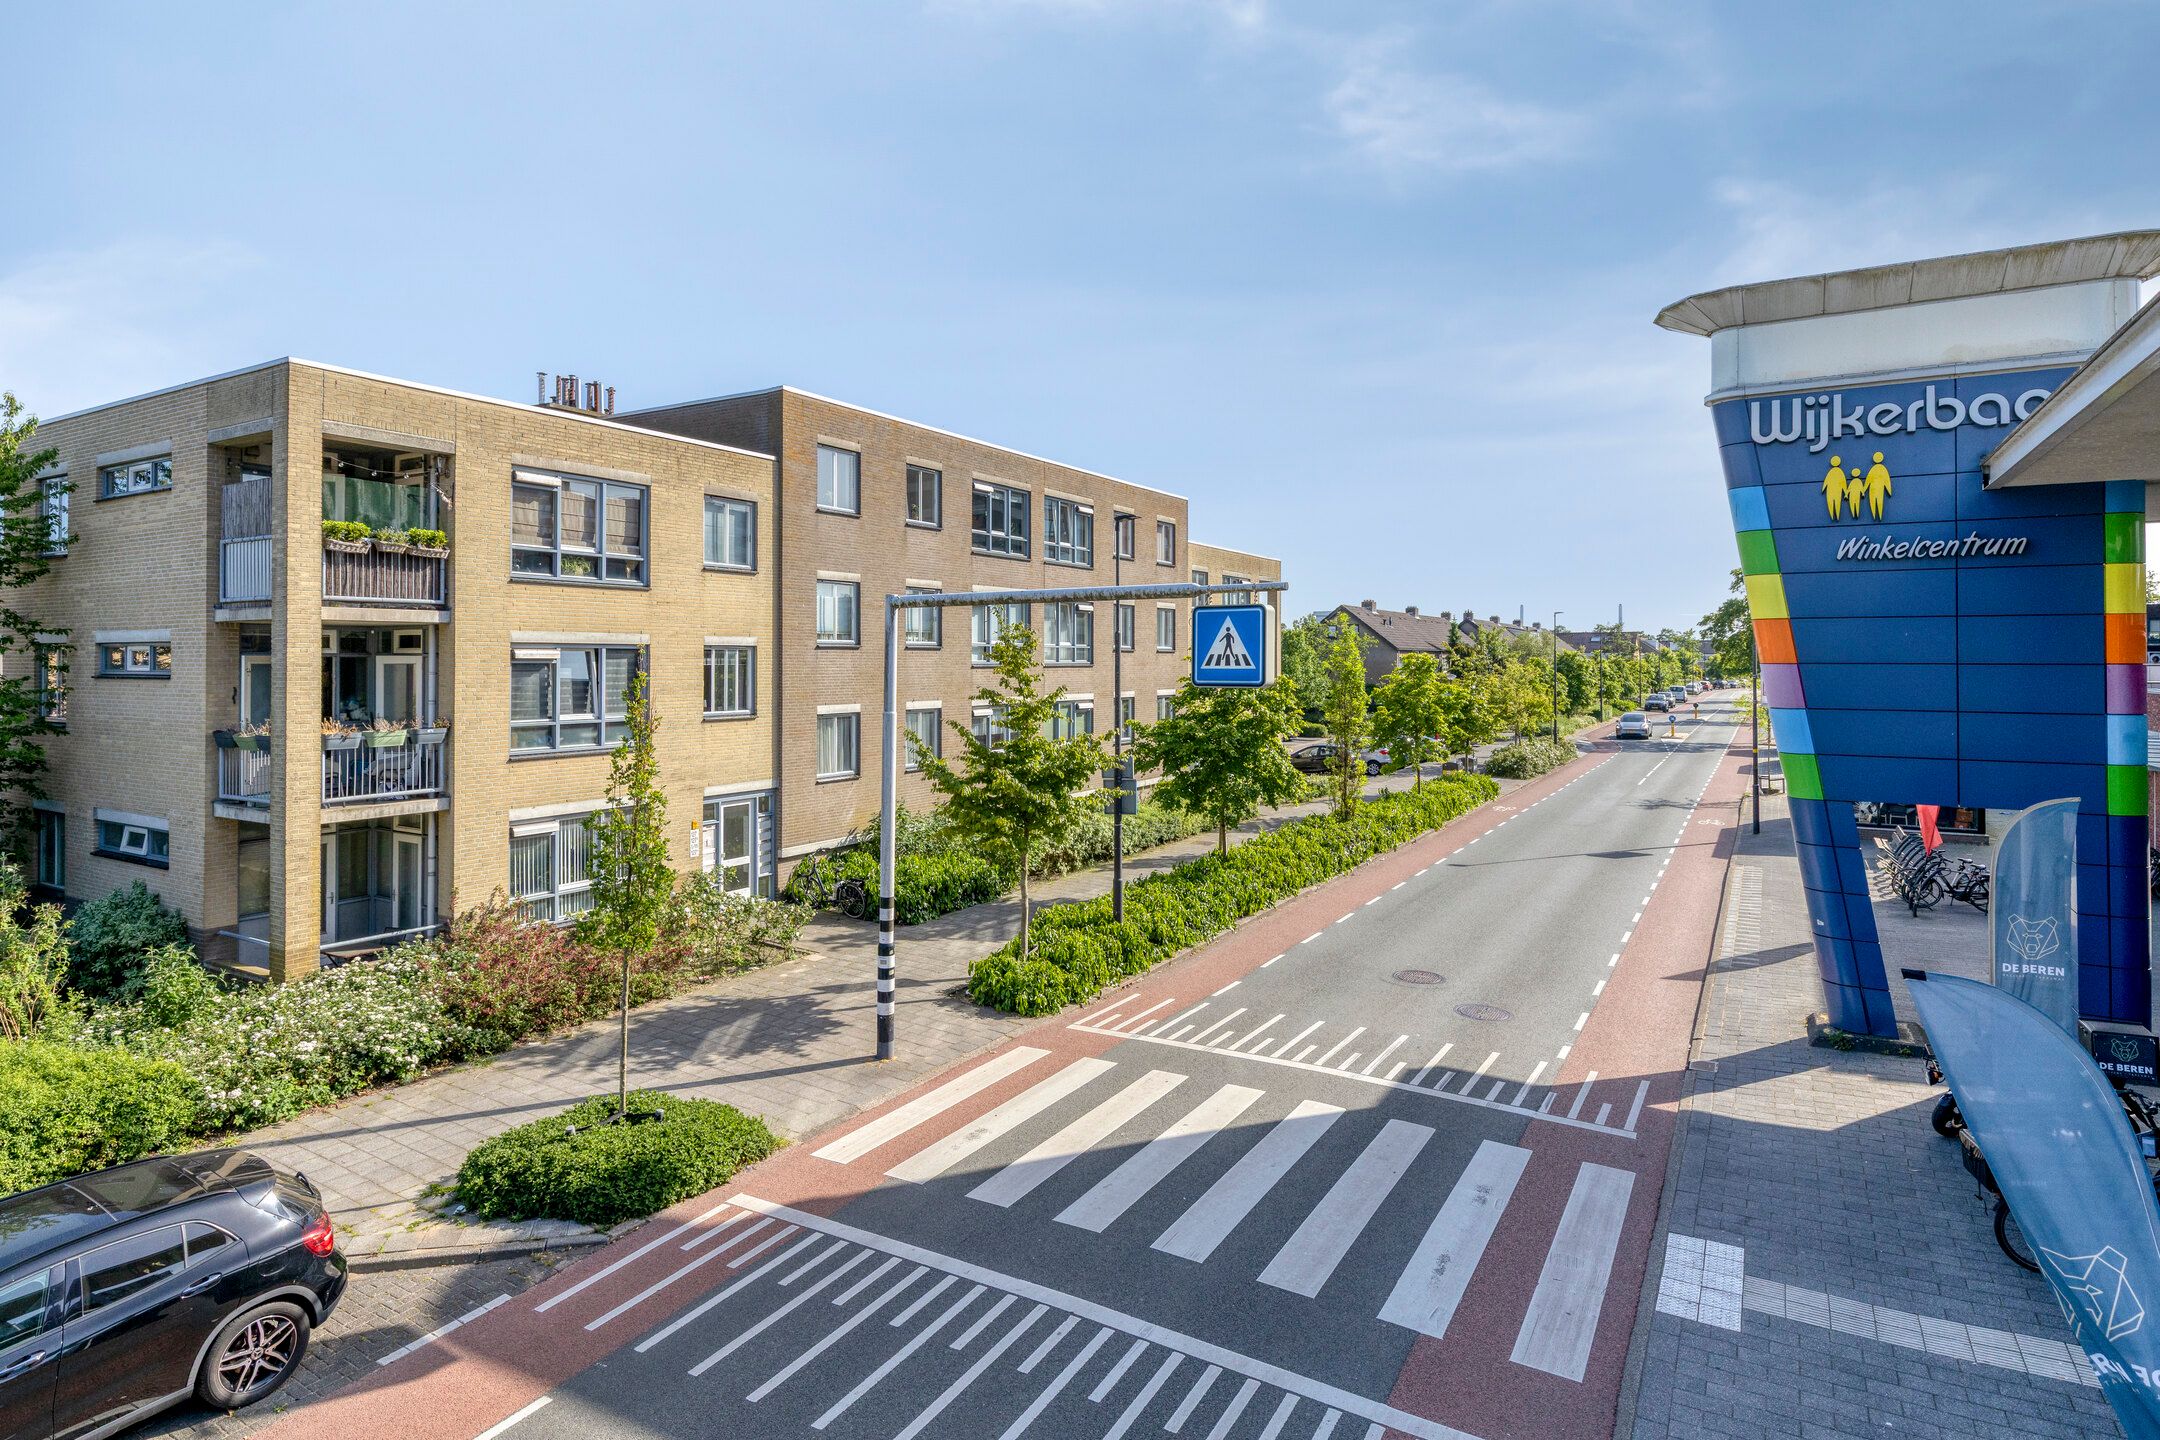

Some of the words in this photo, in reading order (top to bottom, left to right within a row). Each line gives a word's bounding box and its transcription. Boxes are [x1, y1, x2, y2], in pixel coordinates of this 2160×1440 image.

[1836, 530, 2028, 561] Winkelcentrum
[2002, 962, 2020, 973] DE
[2022, 964, 2065, 977] BEREN
[2099, 1061, 2114, 1071] DE
[2116, 1063, 2153, 1075] BEREN
